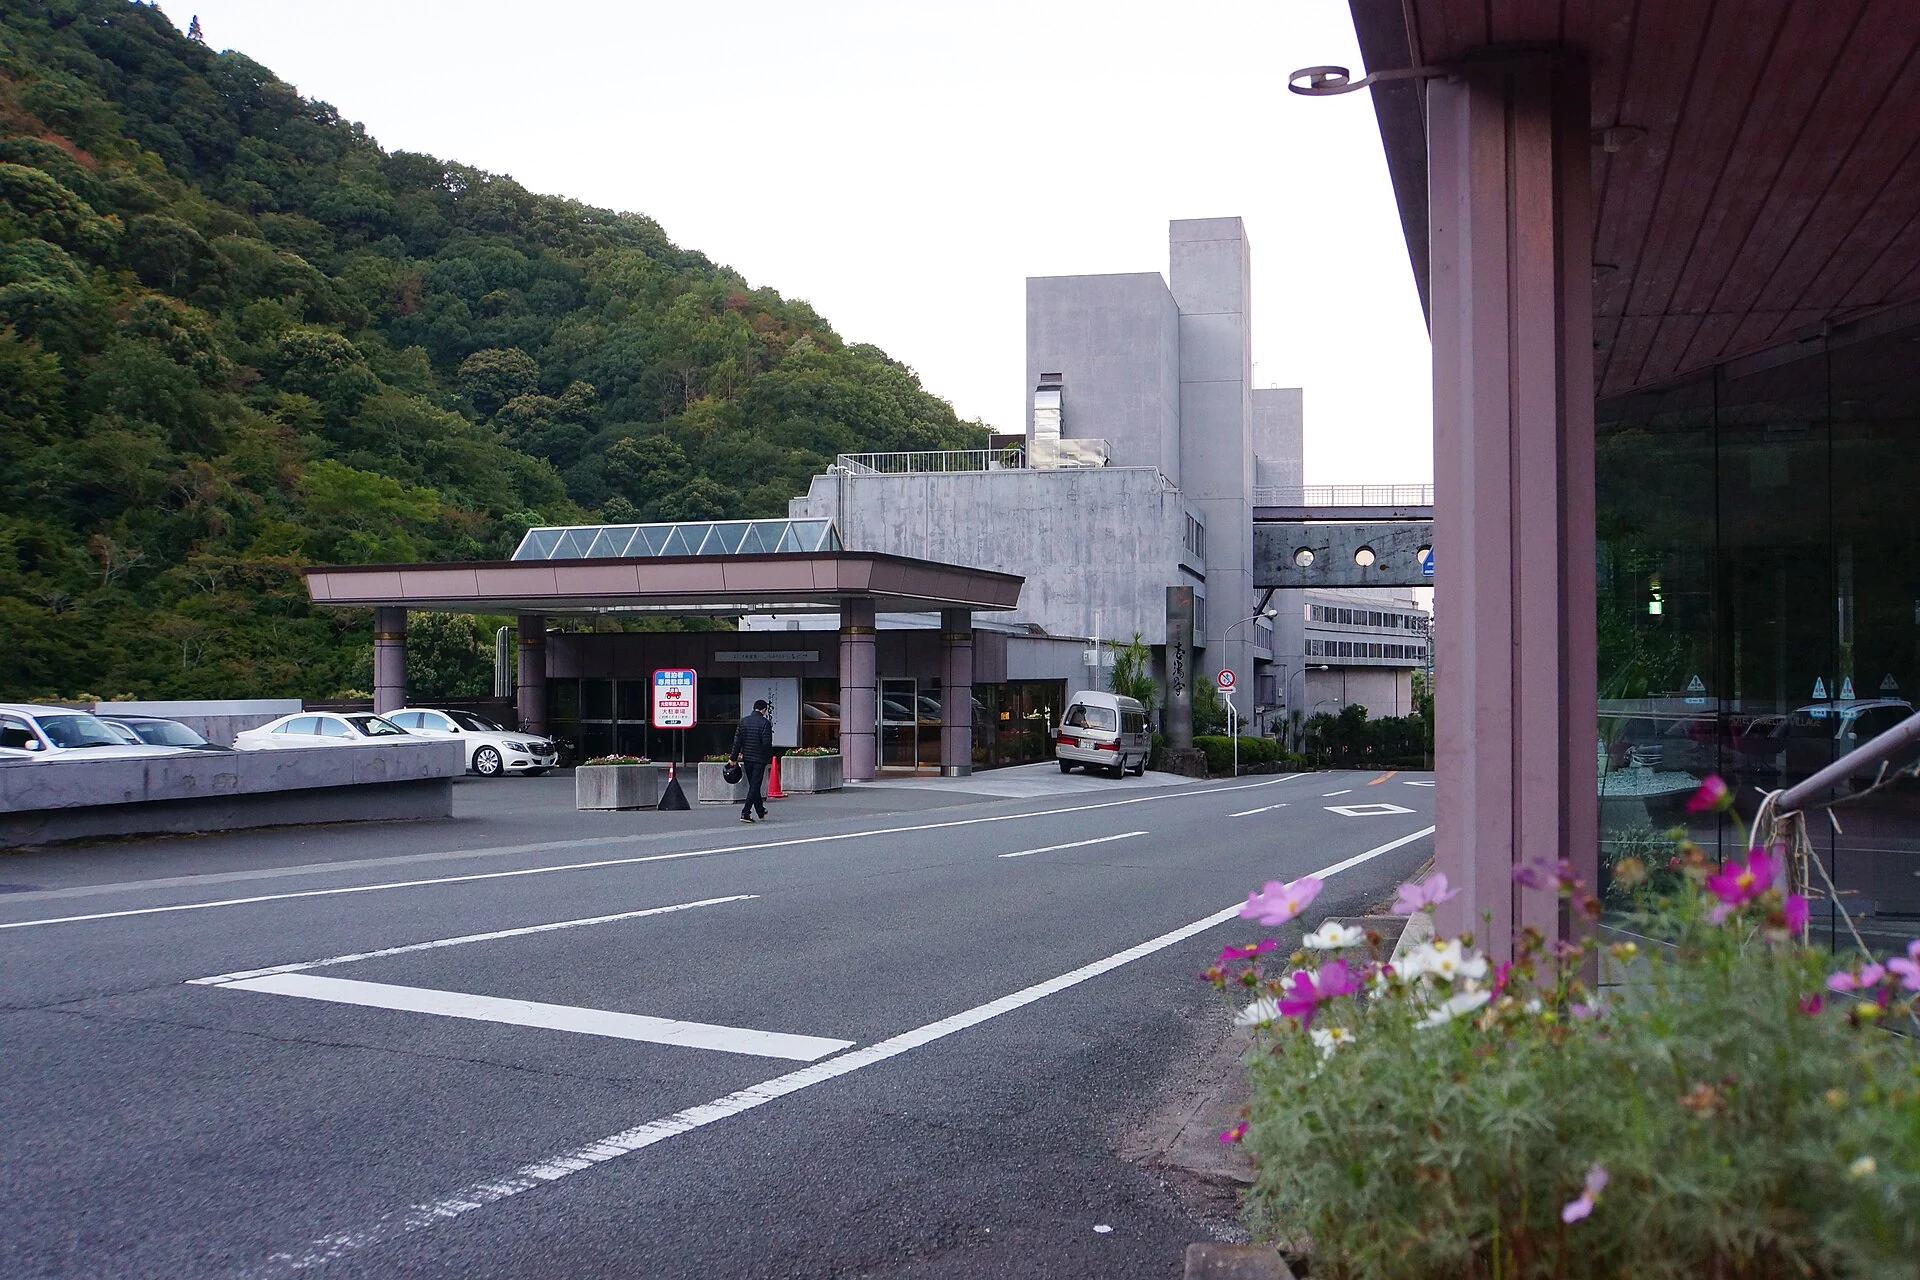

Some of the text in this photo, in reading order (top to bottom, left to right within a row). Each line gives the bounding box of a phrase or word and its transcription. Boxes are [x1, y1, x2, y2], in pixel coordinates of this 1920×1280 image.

[657, 678, 691, 686] 専用駐車場
[1728, 716, 1750, 725] HOTEL
[1790, 717, 1822, 728] VILLAGE
